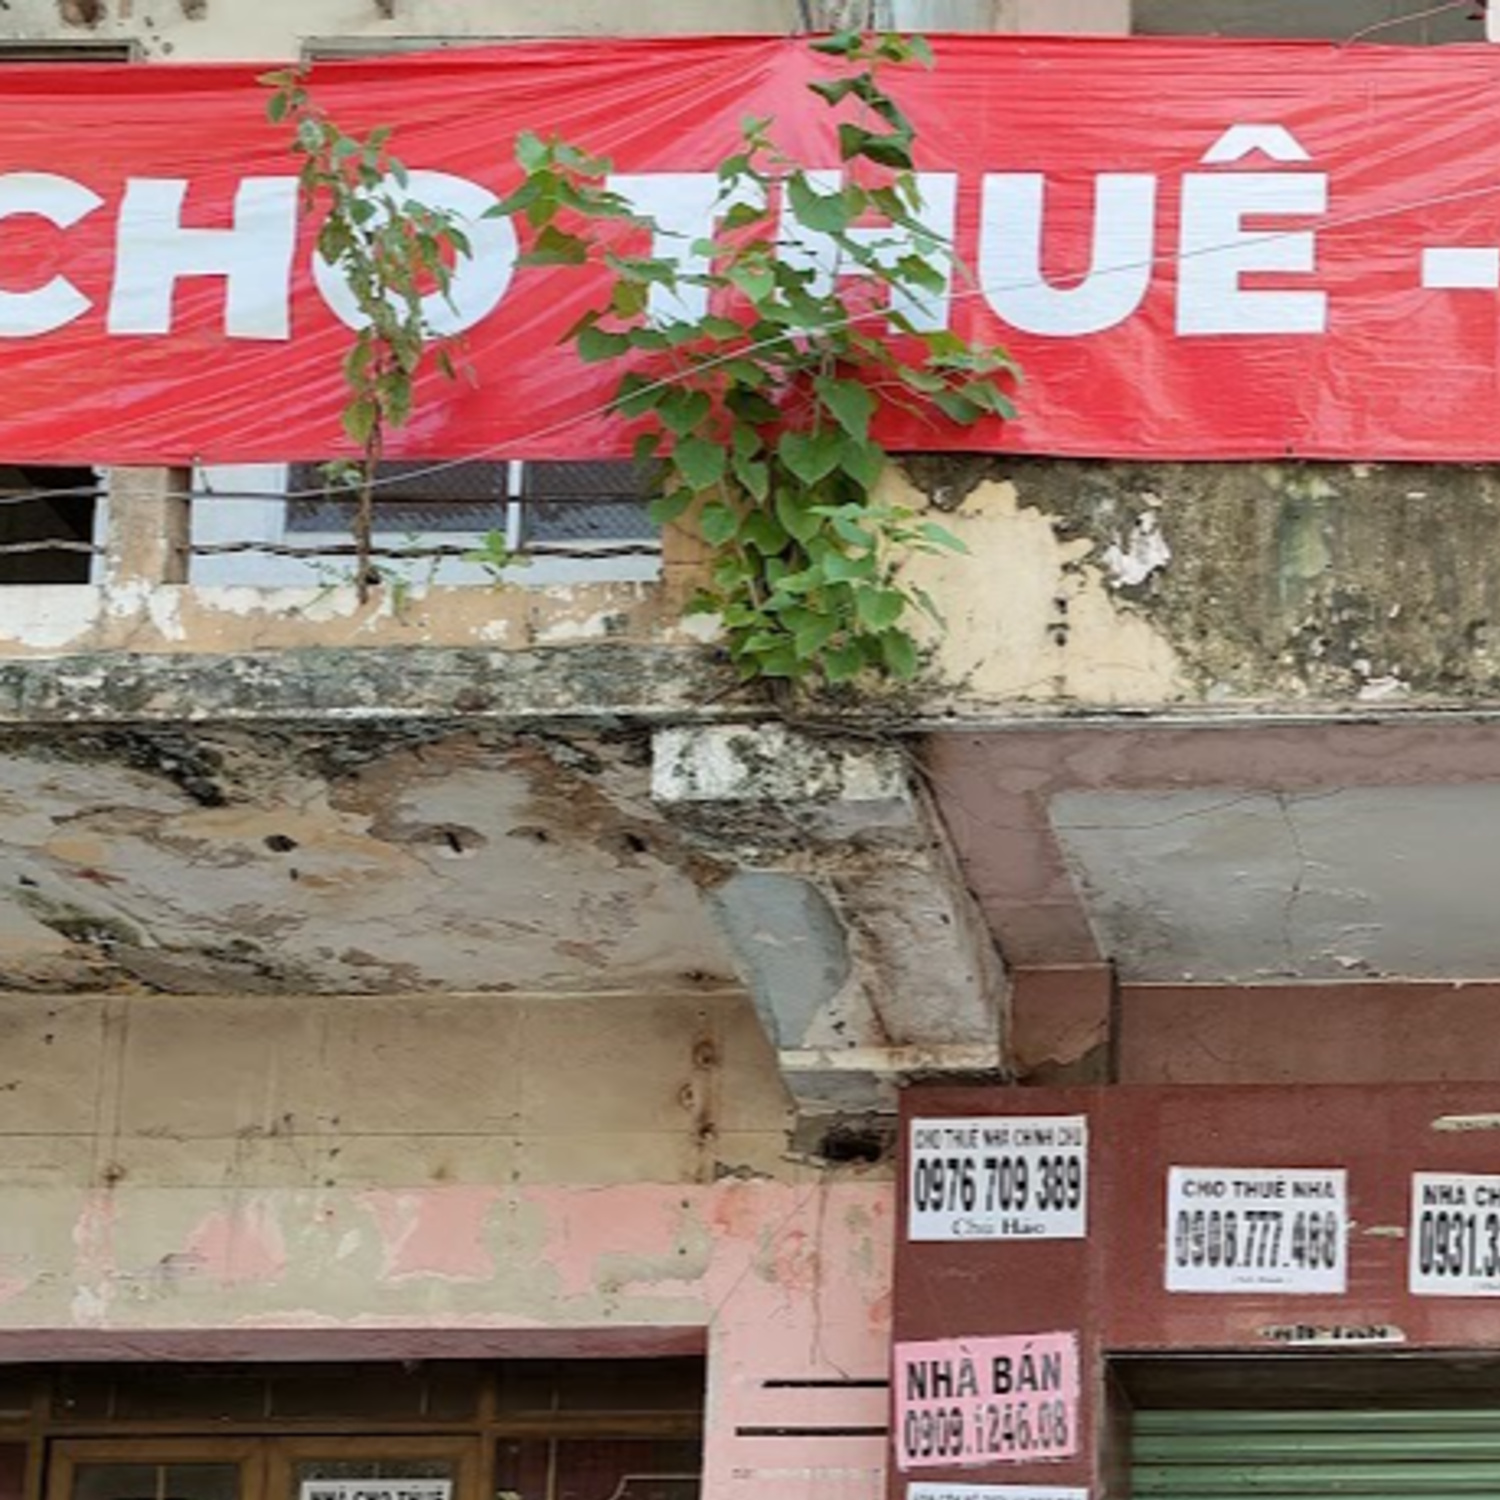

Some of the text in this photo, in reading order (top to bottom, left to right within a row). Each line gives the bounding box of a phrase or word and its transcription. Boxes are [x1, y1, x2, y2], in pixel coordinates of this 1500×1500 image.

[914, 1154, 1082, 1213] 0976 709 389
[1181, 1180, 1227, 1199] CHO
[906, 1341, 1062, 1401] NHÀ BÁN
